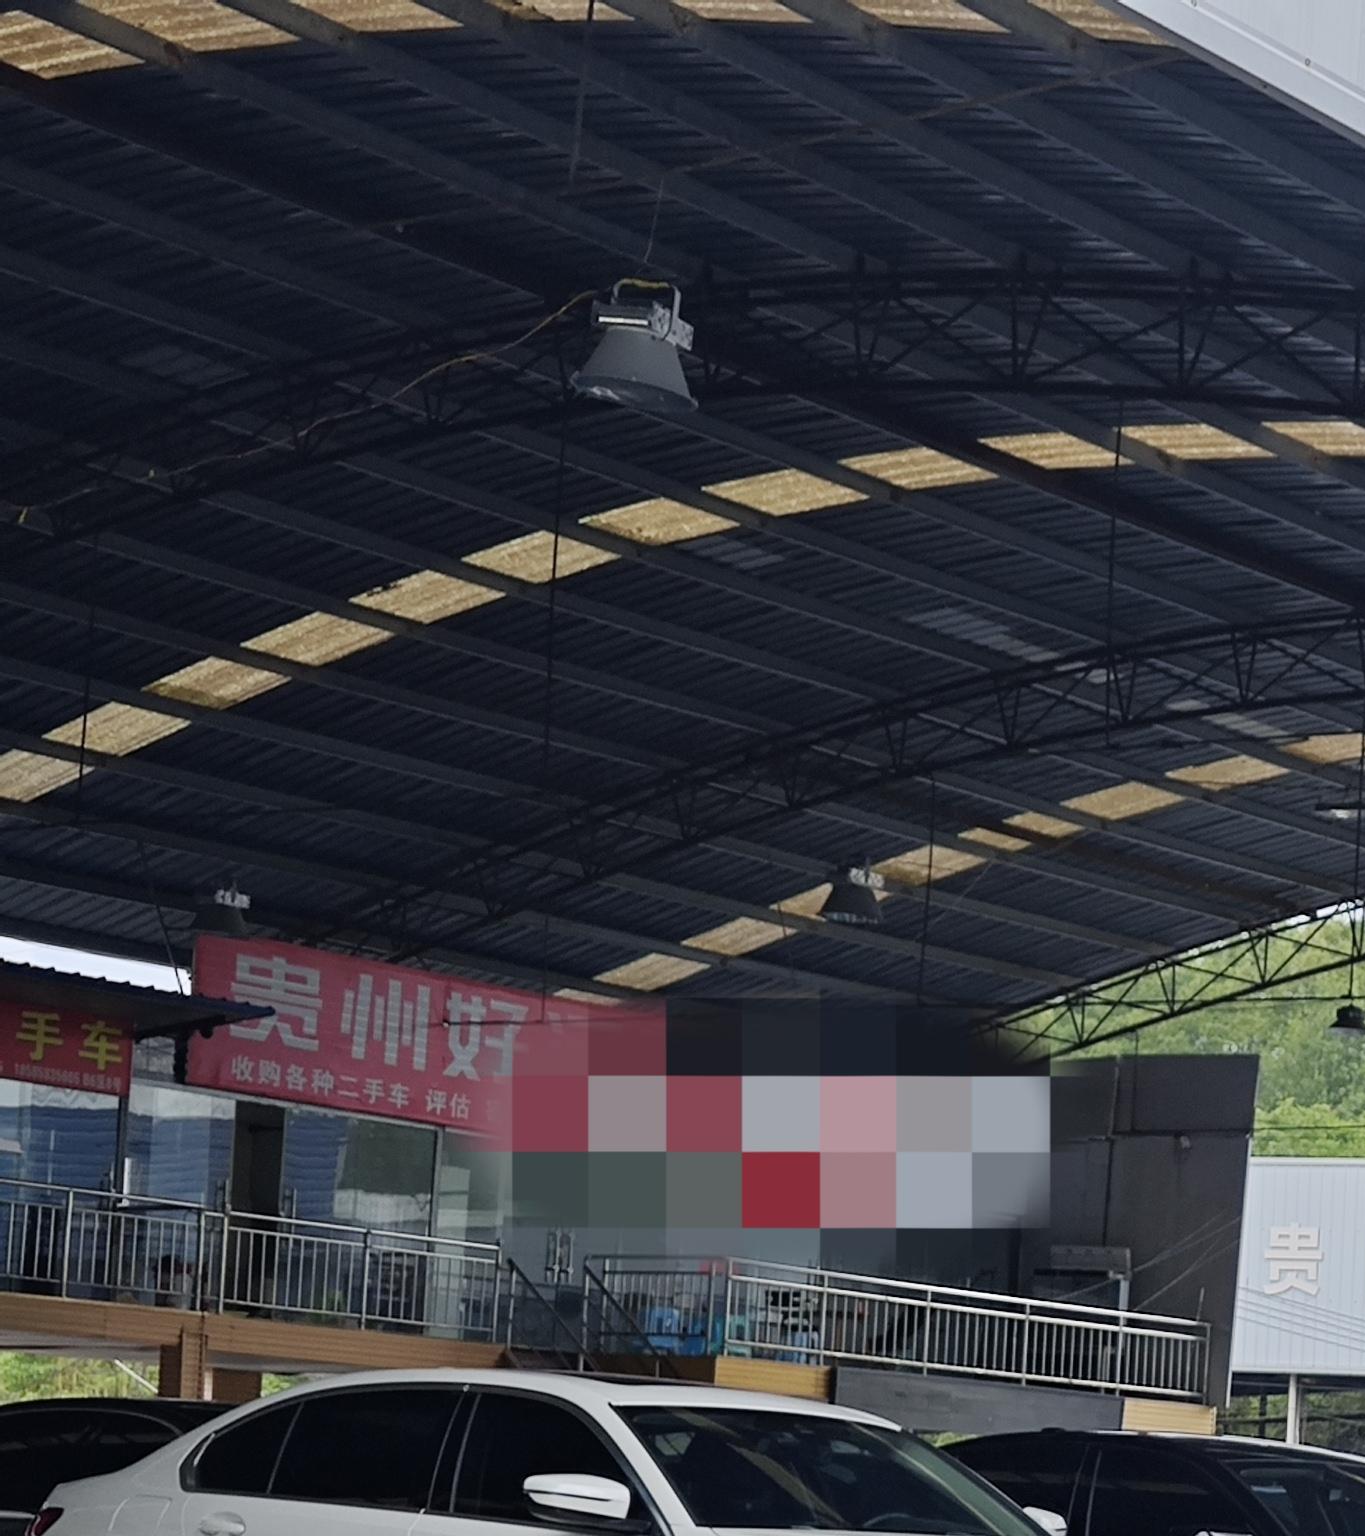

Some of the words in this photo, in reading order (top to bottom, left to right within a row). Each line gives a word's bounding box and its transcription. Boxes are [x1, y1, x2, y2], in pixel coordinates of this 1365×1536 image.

[231, 1055, 411, 1109] 收购各种二手车
[426, 1089, 472, 1120] 评估
